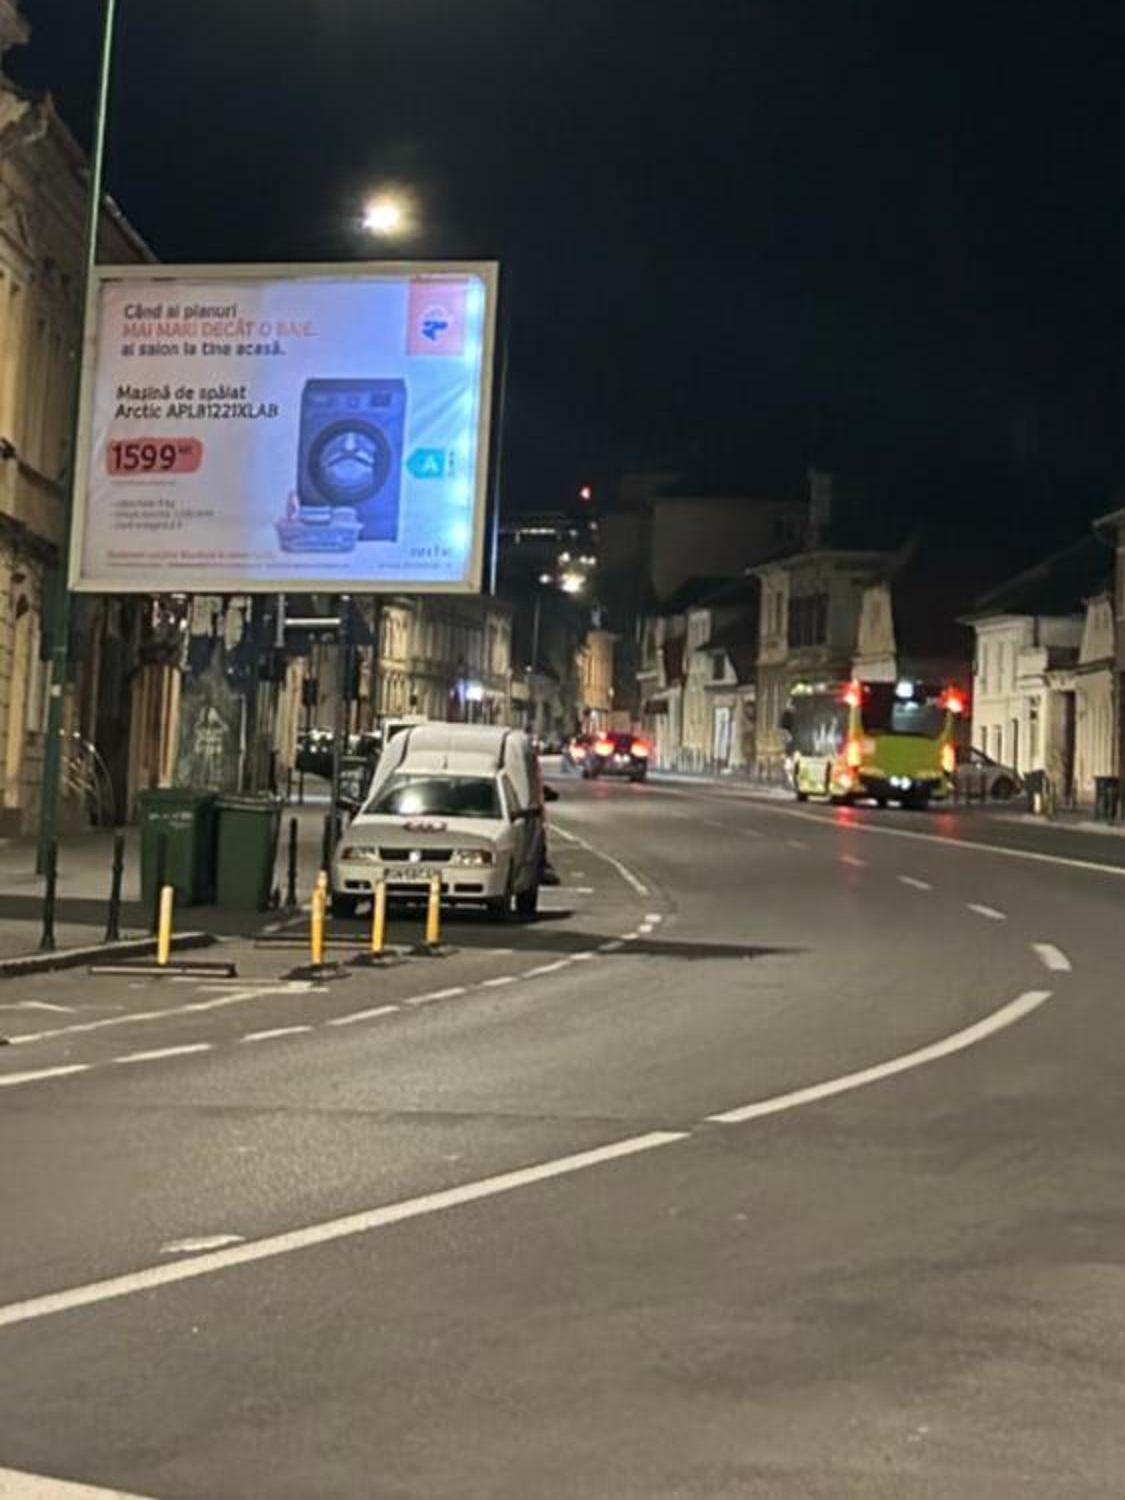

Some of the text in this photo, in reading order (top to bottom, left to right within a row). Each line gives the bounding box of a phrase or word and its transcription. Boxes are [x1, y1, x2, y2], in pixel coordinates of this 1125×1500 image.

[124, 303, 238, 321] Când ai planuri
[122, 322, 154, 337] MAI
[157, 322, 198, 337] MARI
[121, 342, 135, 356] ai
[138, 341, 179, 356] salon
[183, 341, 197, 356] la
[202, 341, 232, 356] tine
[175, 384, 195, 400] de
[114, 403, 161, 419] Arctic
[112, 443, 176, 470] 1599
